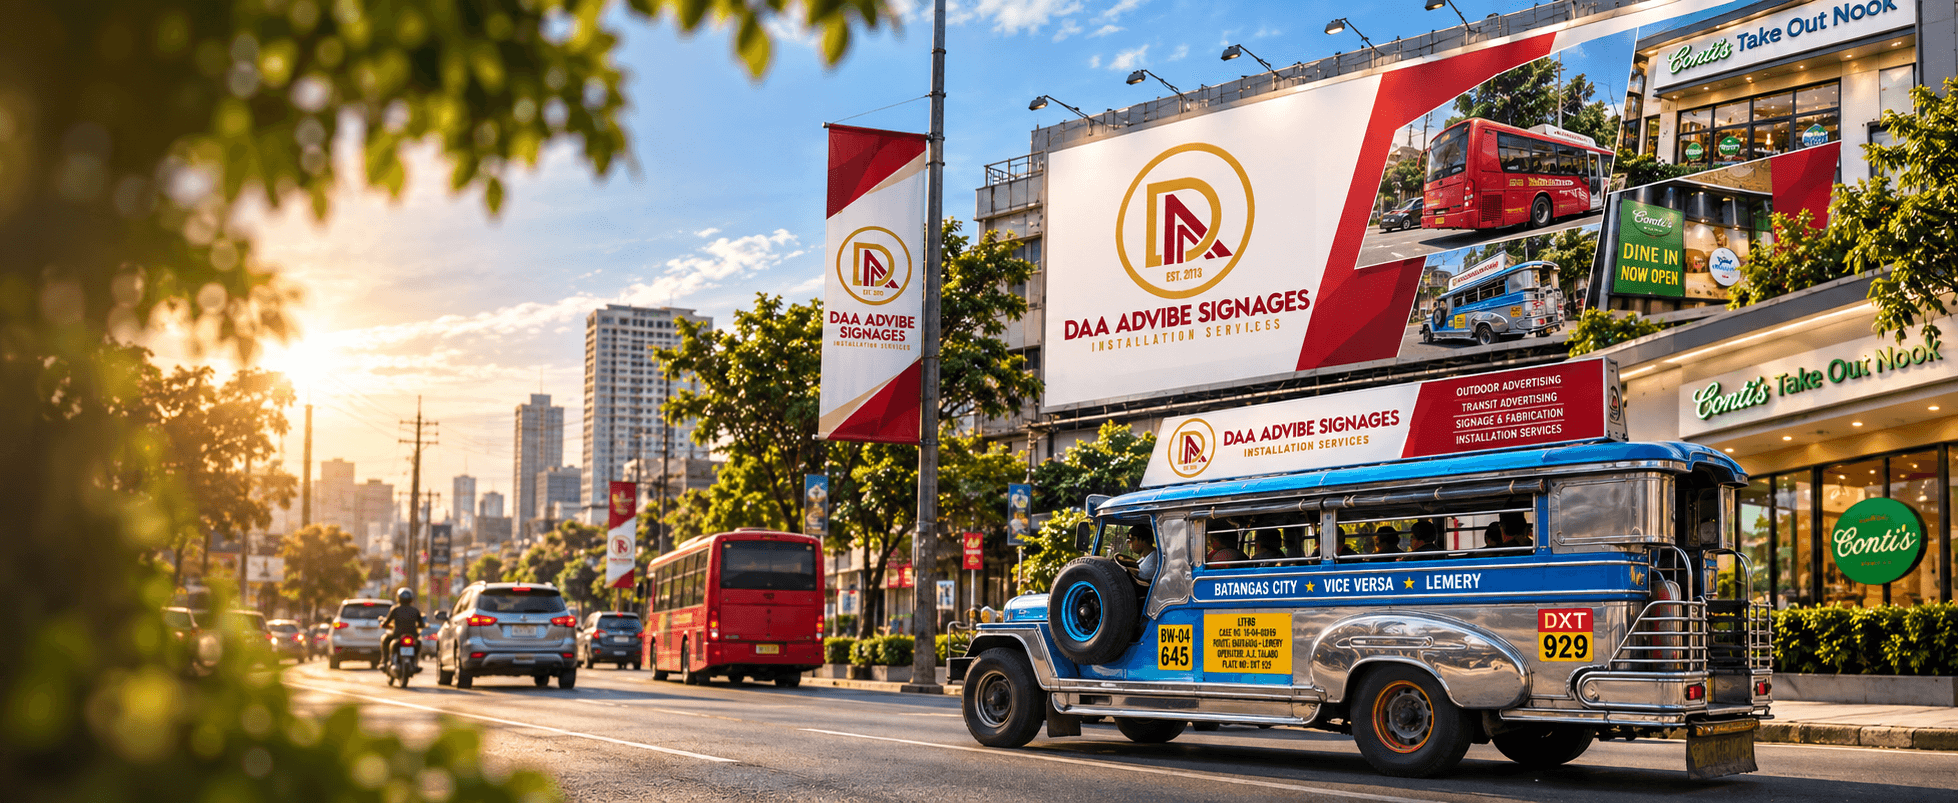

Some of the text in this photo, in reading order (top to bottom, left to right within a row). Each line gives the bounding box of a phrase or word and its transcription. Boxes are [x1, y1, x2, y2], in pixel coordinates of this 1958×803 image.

[1737, 27, 1782, 52] Take
[1787, 11, 1827, 37] Out
[1833, 0, 1897, 26] Nook
[1623, 242, 1678, 265] DINE IN
[1166, 271, 1182, 282] EST.
[1620, 265, 1678, 285] NOW OPEN
[830, 311, 915, 329] DAA ADVIBE
[1064, 289, 1310, 340] DAA ADVIBE SIGNAGES
[840, 326, 905, 341] SIGNAGES
[1091, 329, 1195, 352] INSTALLATION
[1456, 375, 1562, 396] OUTDOOR ADVERTISING
[1692, 336, 1943, 419] Conti's Take Out Nook
[1462, 392, 1558, 412] TRANSIT ADVERTISING
[1224, 410, 1400, 446] DAA ADVIBE SIGNAGES
[1456, 415, 1494, 428] SIGNAGE
[1505, 408, 1564, 424] FABRICATION
[1456, 424, 1562, 445] INSTALLATION SERVICES
[1244, 435, 1369, 457] INSTALLATION SERVICES
[1834, 524, 1917, 557] Conti's
[1214, 573, 1481, 596] BATANGAS CITY VICE VERSA LEMERY
[1544, 612, 1587, 628] DXT
[1161, 628, 1190, 643] BW-04
[1161, 646, 1189, 666] 645
[1543, 635, 1588, 659] 929
